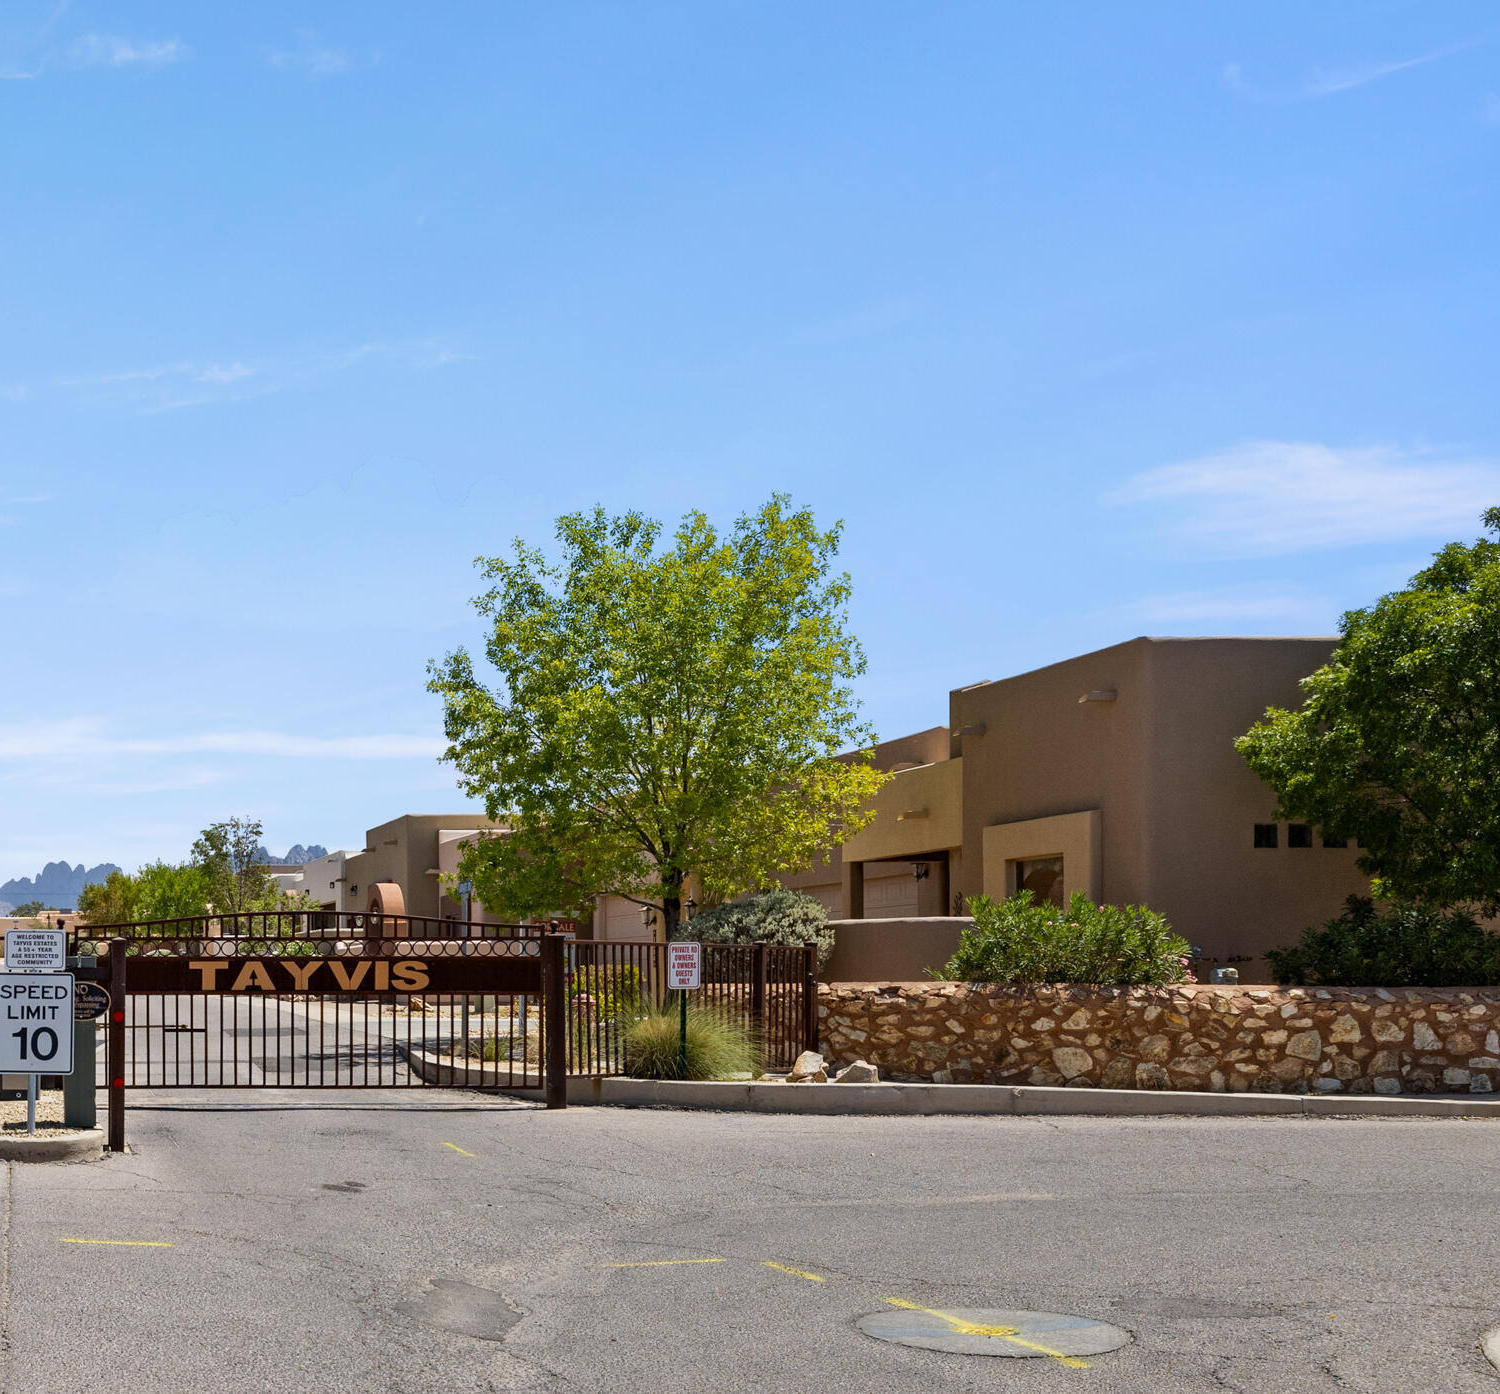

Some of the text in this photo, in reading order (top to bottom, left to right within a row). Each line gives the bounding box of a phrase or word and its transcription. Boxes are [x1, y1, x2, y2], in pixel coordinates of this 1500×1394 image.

[556, 923, 575, 932] ALE
[189, 960, 430, 991] TAYVIS
[0, 985, 68, 1000] SPEED
[7, 1005, 60, 1020] LIMIT
[12, 1026, 59, 1061] 10
